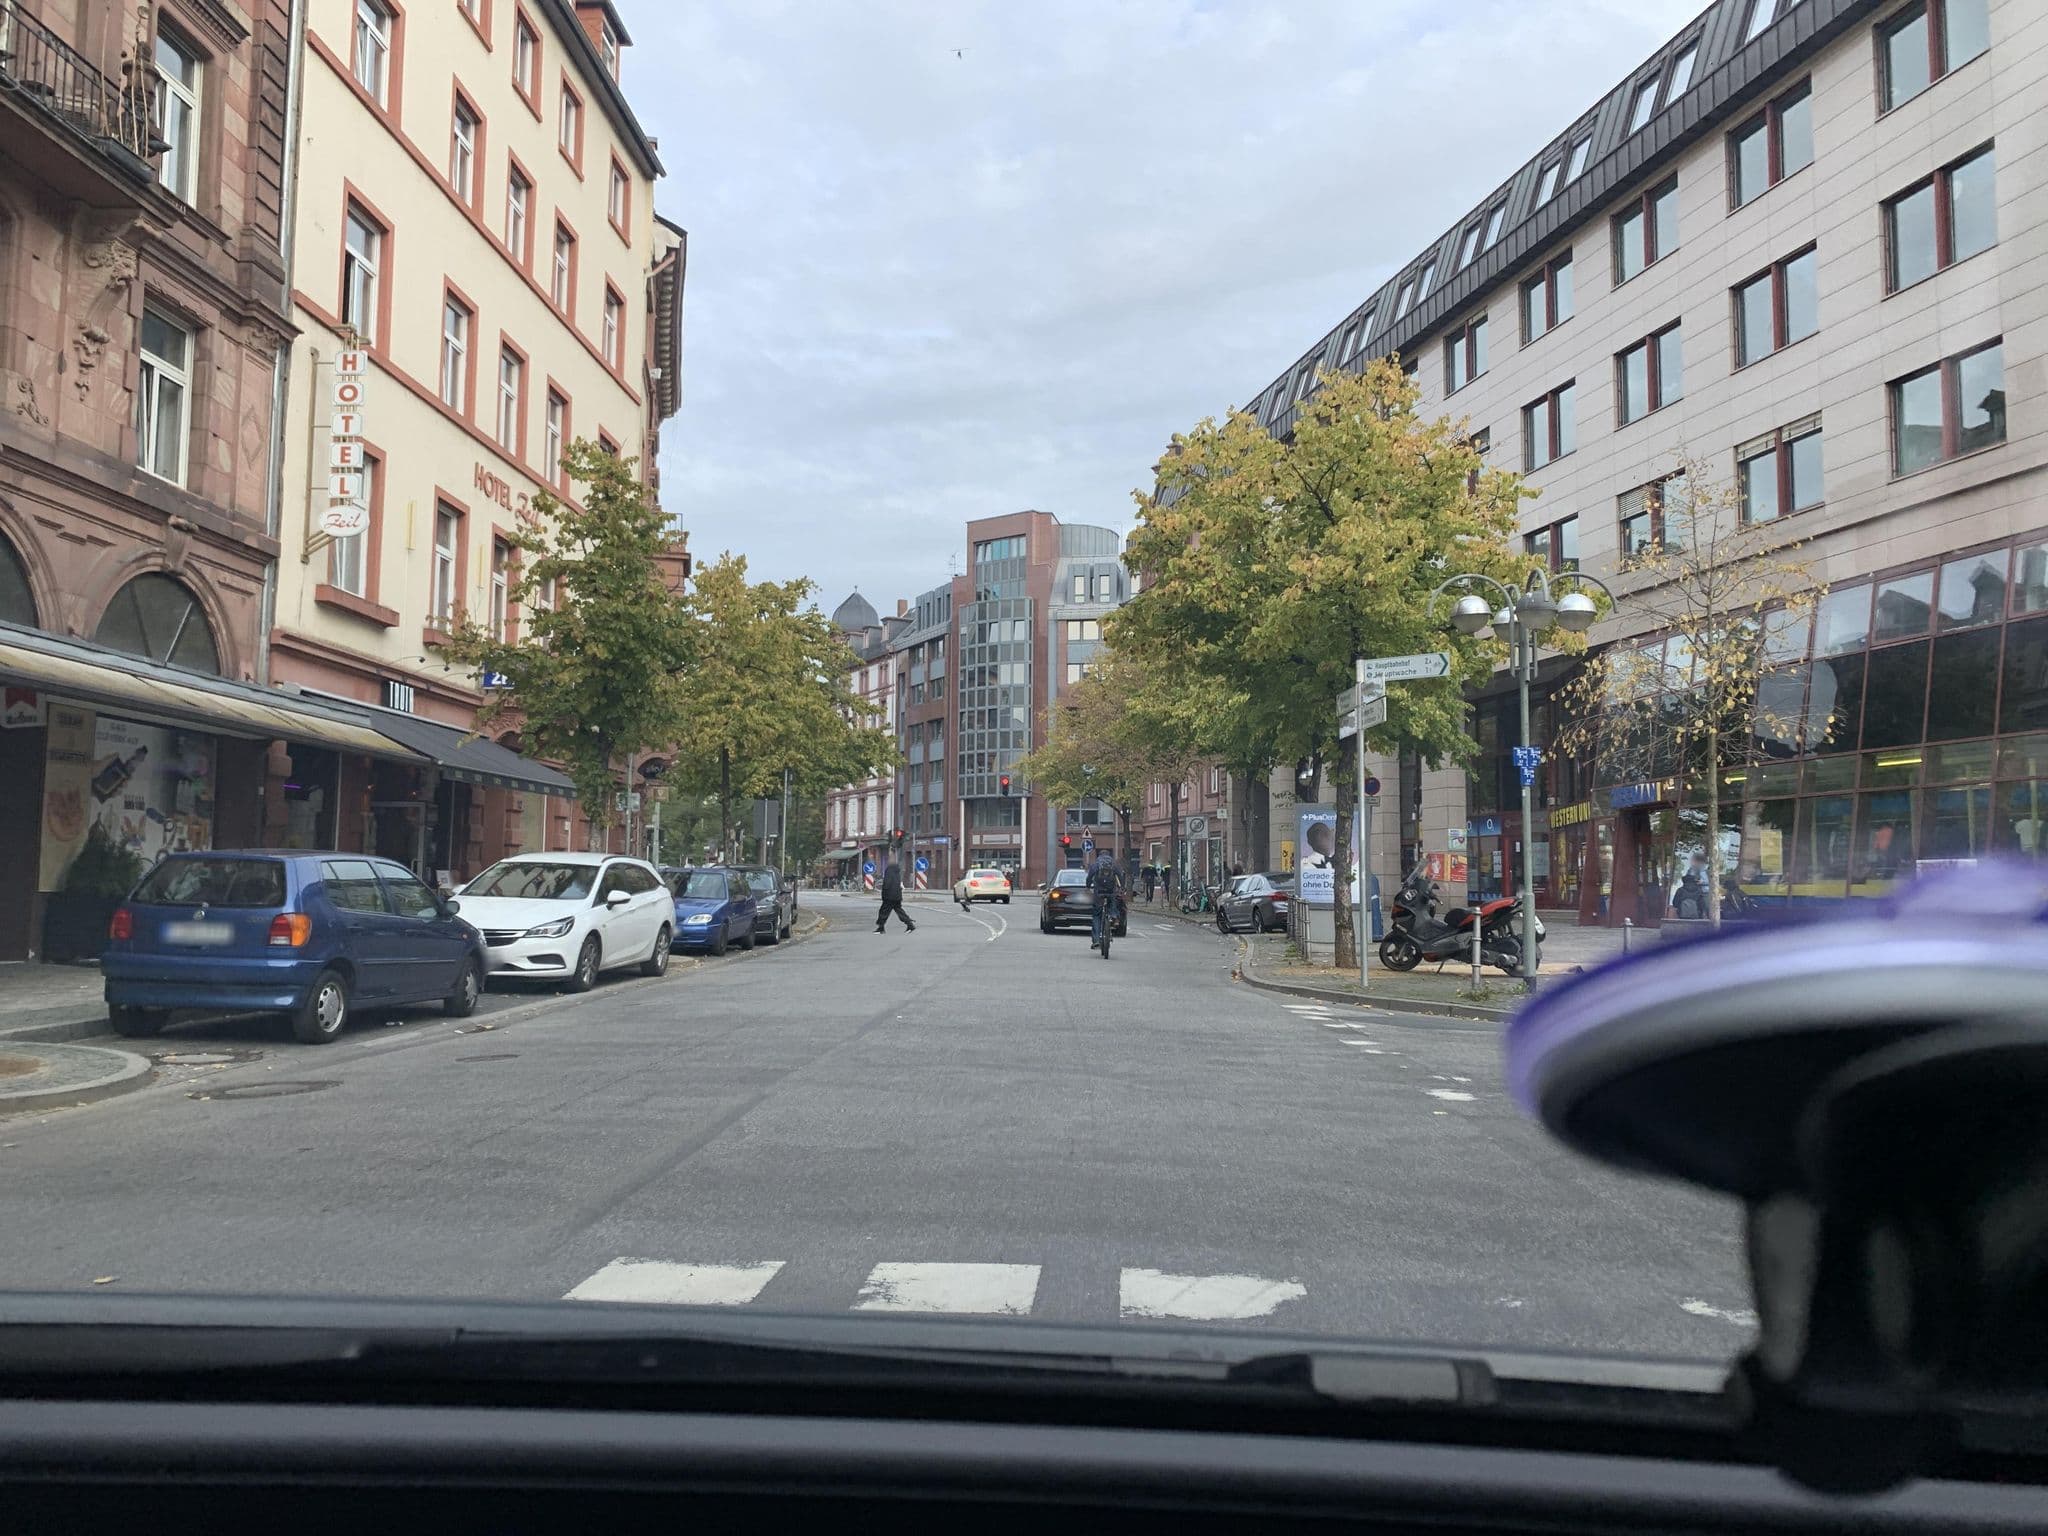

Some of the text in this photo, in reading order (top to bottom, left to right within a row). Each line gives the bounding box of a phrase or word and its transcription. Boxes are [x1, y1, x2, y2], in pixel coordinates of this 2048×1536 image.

[338, 354, 359, 495] HOTEL
[474, 462, 513, 512] HOTEL
[323, 511, 361, 530] Zeil
[1550, 805, 1578, 829] WESTERN
[1302, 871, 1330, 880] Gerade
